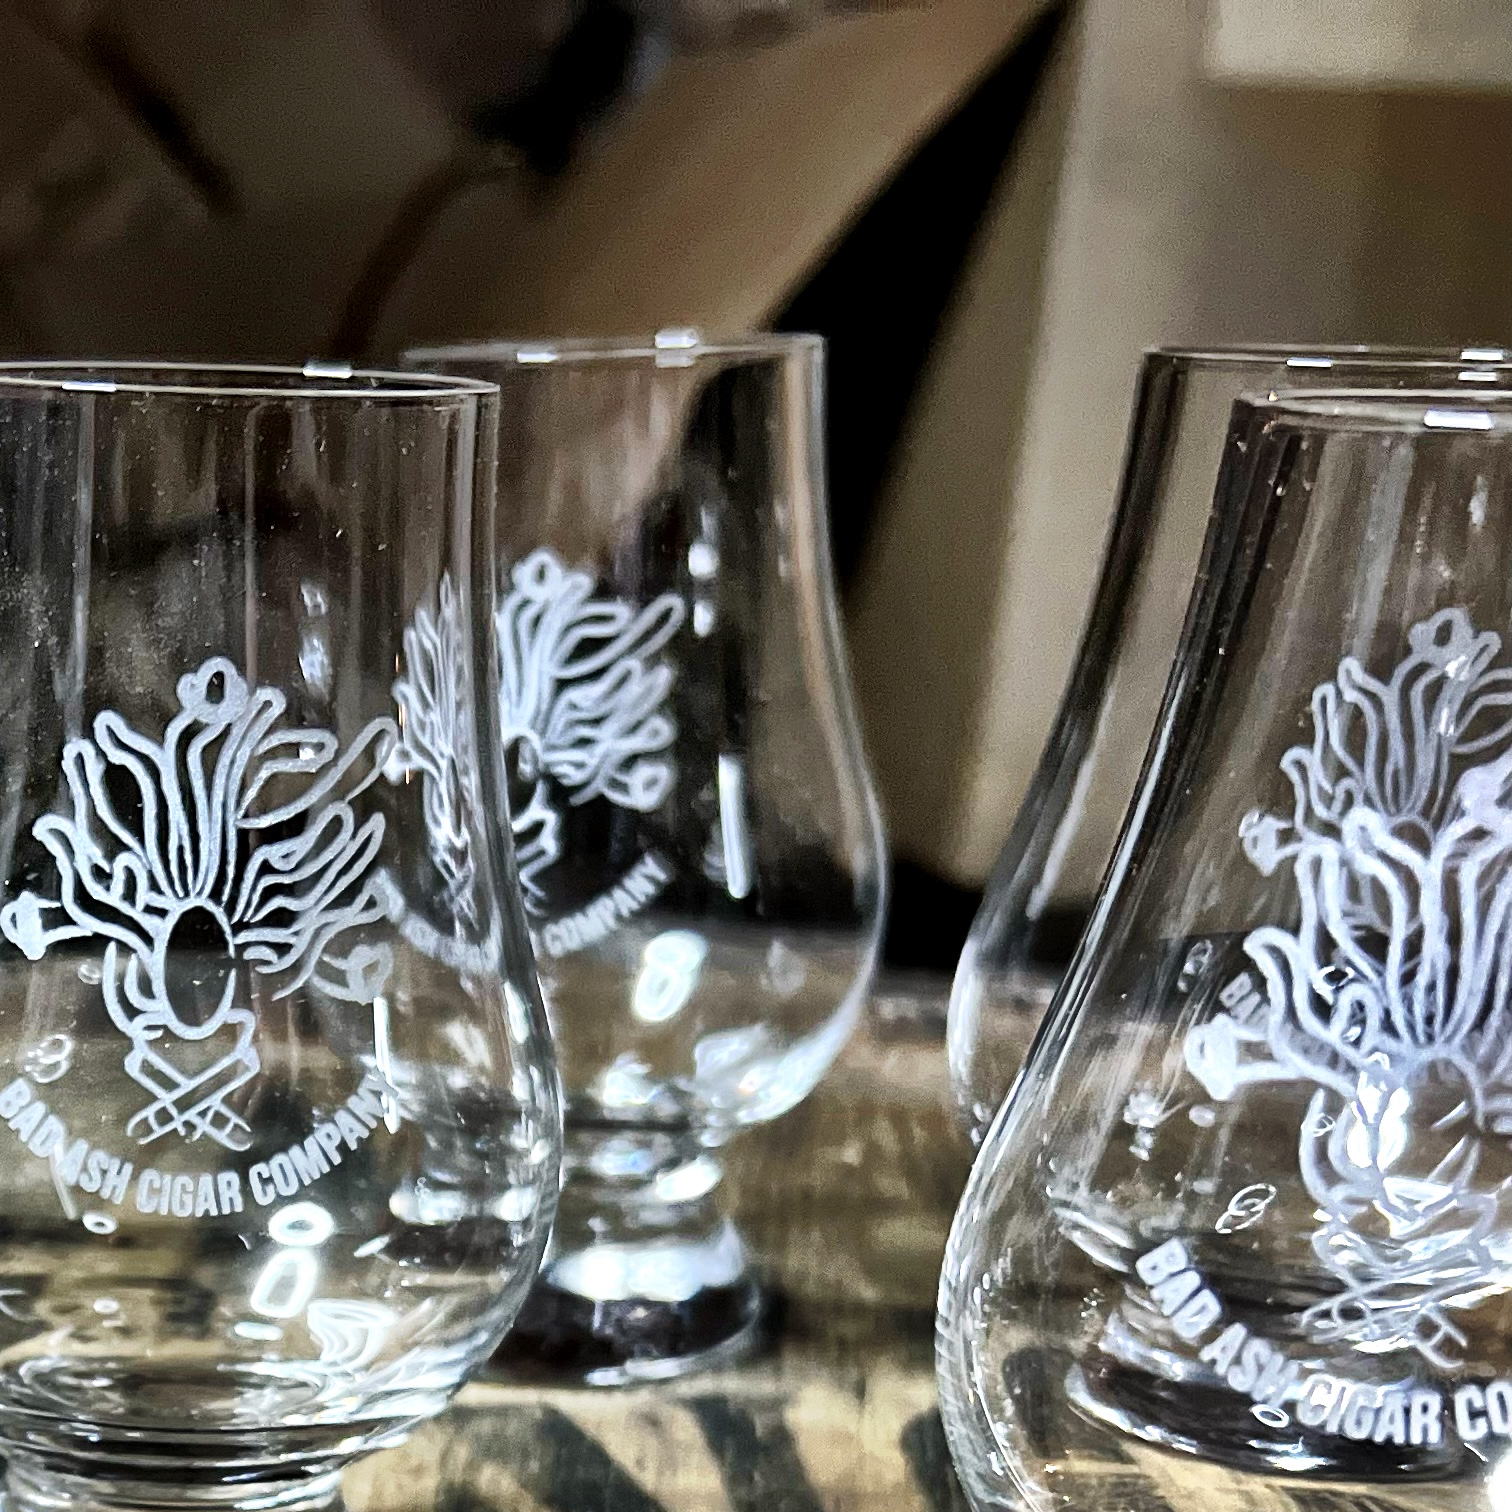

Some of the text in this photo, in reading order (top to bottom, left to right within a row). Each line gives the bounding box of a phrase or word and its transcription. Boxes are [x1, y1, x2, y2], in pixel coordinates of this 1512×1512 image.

[56, 1139, 133, 1205] ASH
[136, 1168, 243, 1217] CIGAR
[1136, 1237, 1223, 1340] BAD
[1198, 1322, 1300, 1405] ASH
[1296, 1374, 1443, 1445] CIGAR
